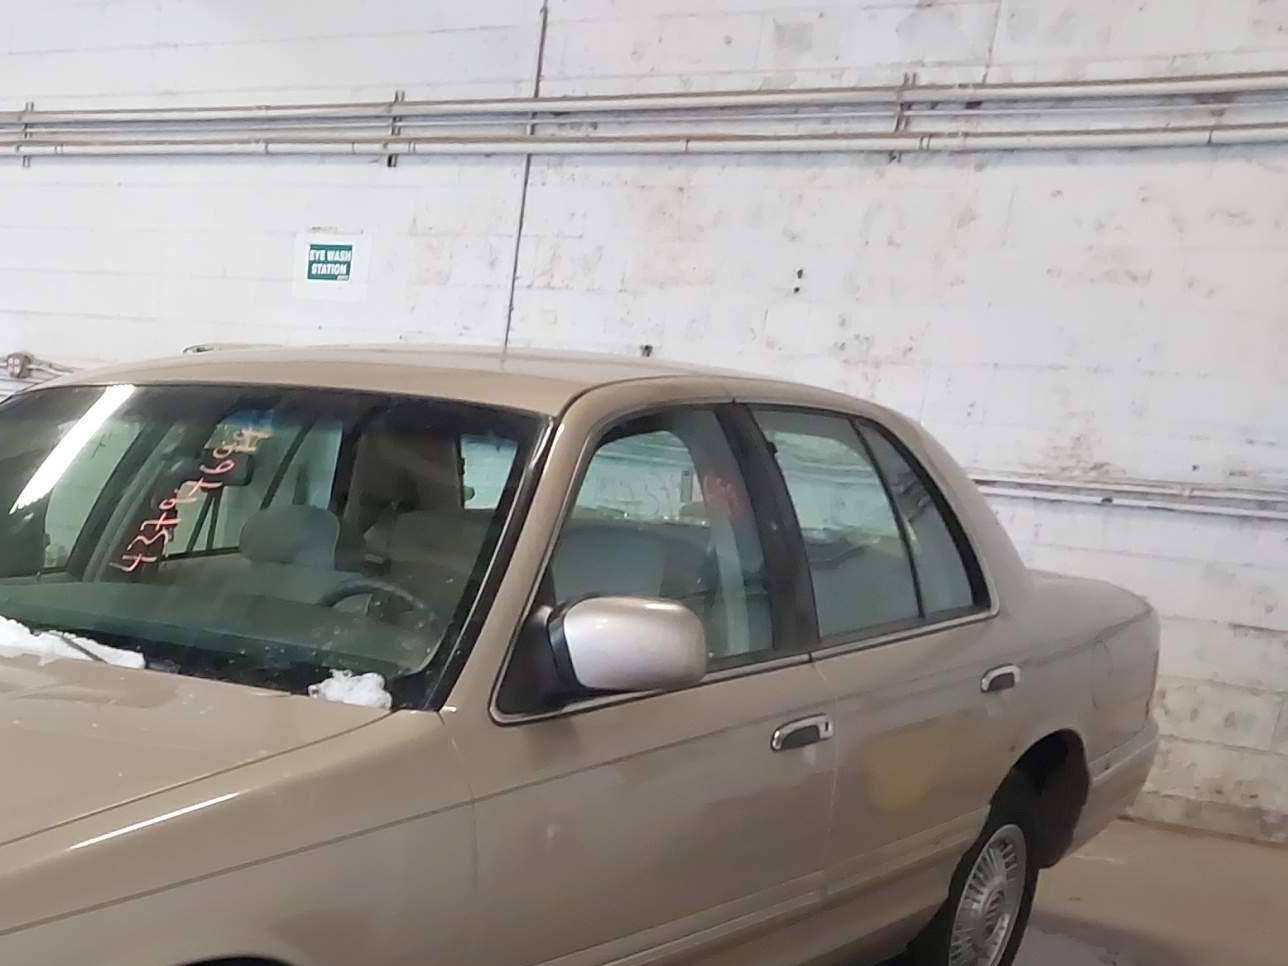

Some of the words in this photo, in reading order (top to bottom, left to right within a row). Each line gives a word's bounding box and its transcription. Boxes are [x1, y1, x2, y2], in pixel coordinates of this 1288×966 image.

[310, 249, 326, 261] EYE
[327, 250, 352, 261] WASH
[311, 262, 348, 275] STATION
